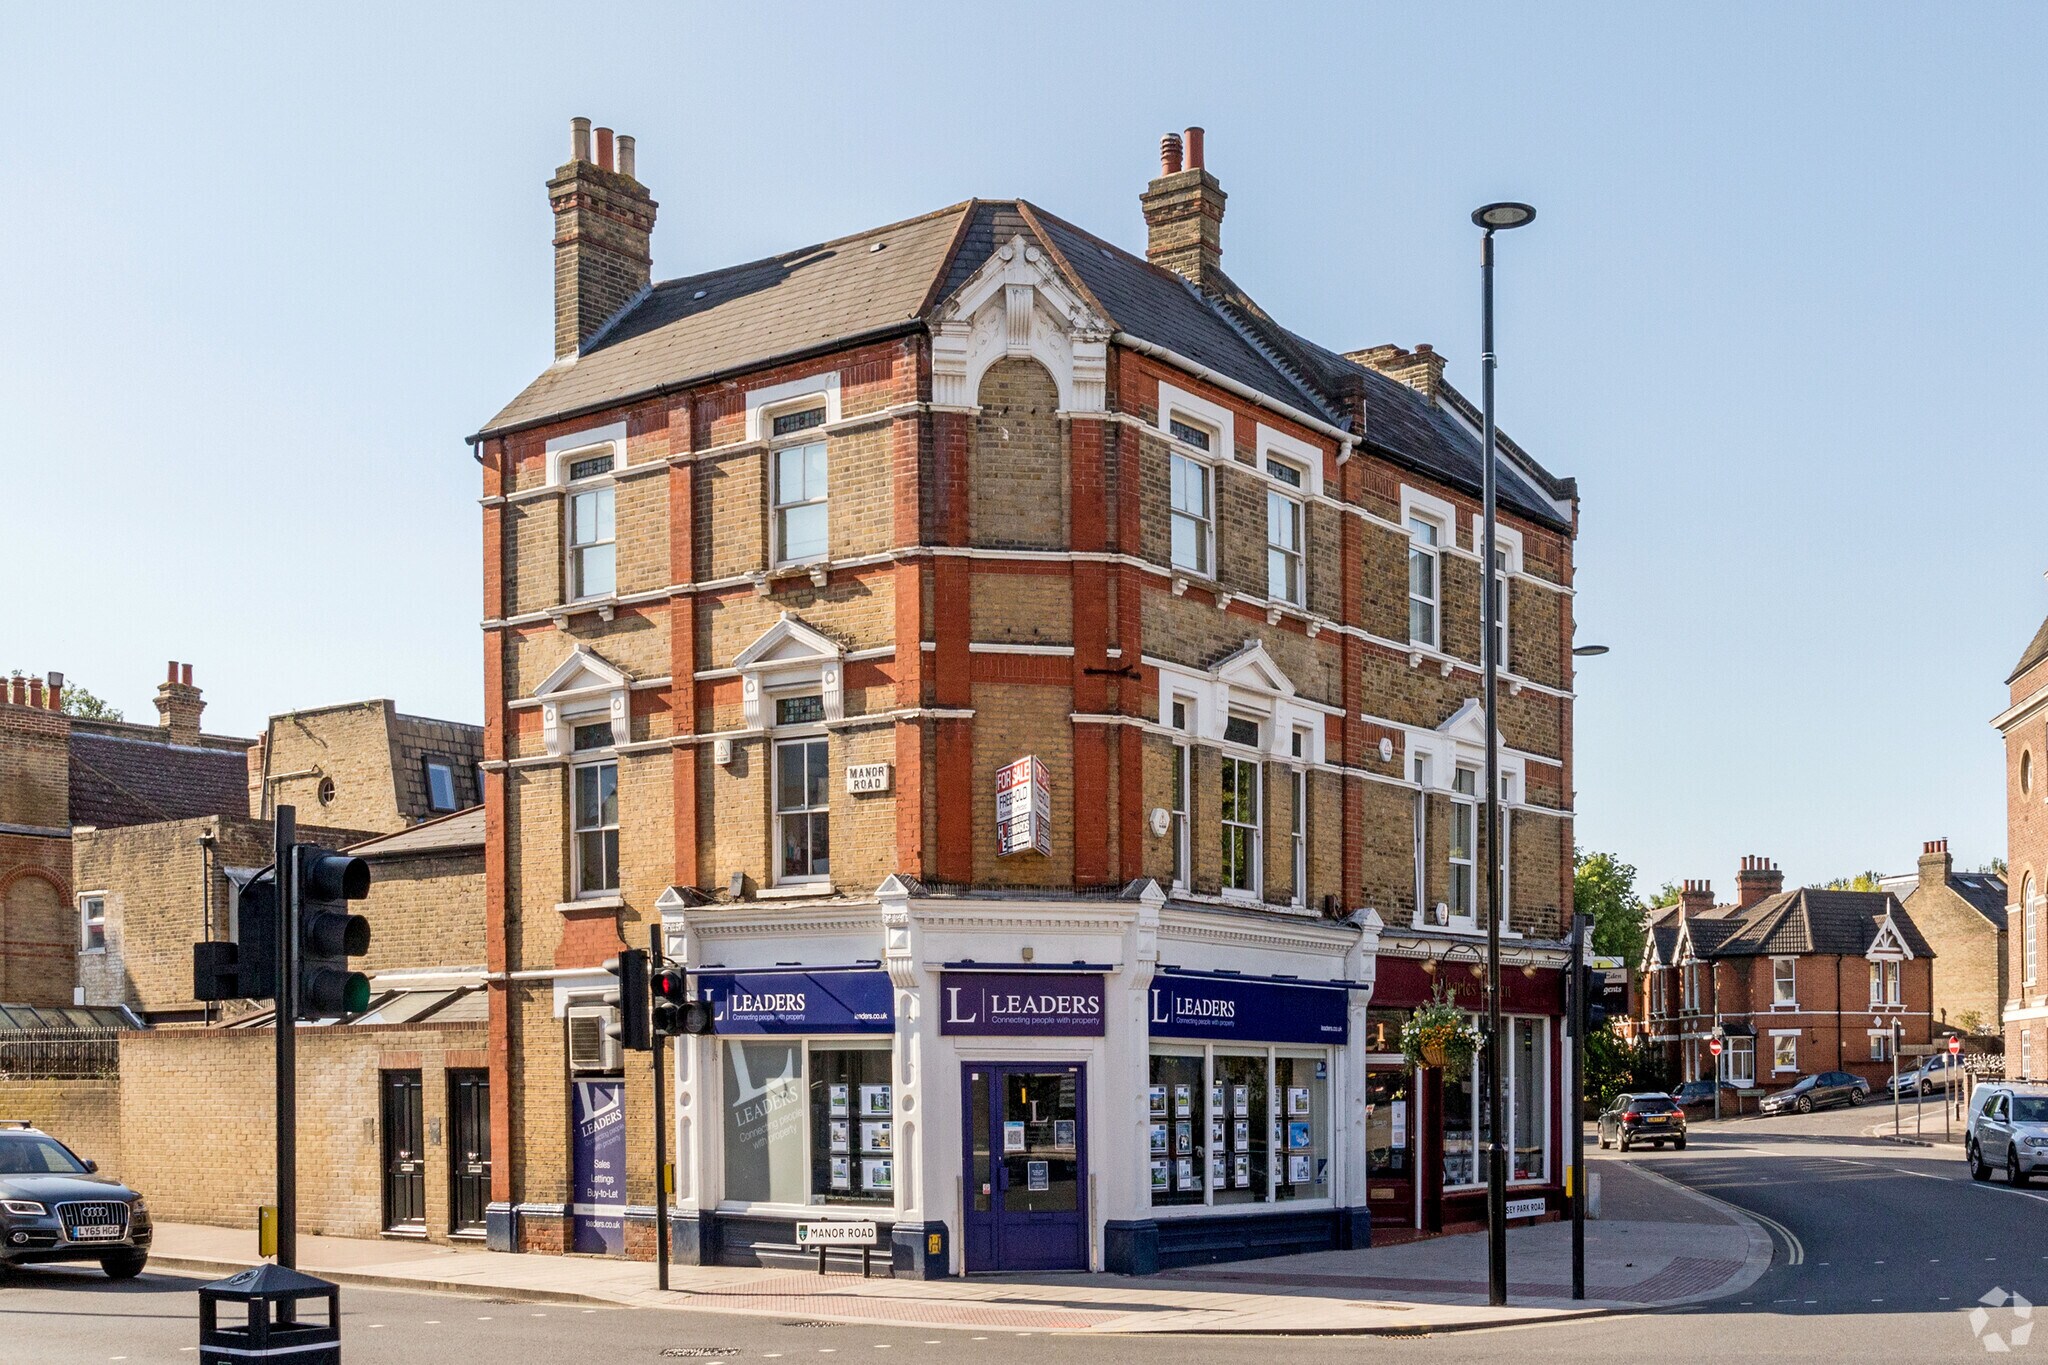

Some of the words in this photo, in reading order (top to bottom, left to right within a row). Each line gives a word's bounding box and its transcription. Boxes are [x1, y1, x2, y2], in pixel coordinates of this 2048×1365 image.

[849, 766, 884, 778] MANOR
[997, 770, 1011, 791] FOR
[1012, 762, 1031, 785] SALE
[853, 778, 881, 790] ROAD
[1603, 986, 1622, 996] gents
[732, 993, 806, 1012] LEADERS
[946, 987, 977, 1023] L
[991, 995, 1100, 1014] LEADERS
[1151, 989, 1169, 1023] L
[1176, 997, 1235, 1018] LEADERS
[732, 1013, 758, 1022] Connecting
[785, 1013, 806, 1021] property
[991, 1015, 1031, 1025] Connecting
[1031, 1016, 1055, 1025] people
[1071, 1017, 1100, 1025] property
[1176, 1016, 1198, 1026] Connecting
[1219, 1020, 1235, 1028] property
[1376, 1022, 1386, 1042] 1
[734, 1085, 799, 1127] LEADERS
[1029, 1100, 1049, 1123] L
[581, 1109, 623, 1138] LEADERS
[609, 1123, 625, 1135] people
[739, 1118, 779, 1143] Connecting
[778, 1108, 803, 1130] people
[603, 1135, 621, 1149] property
[752, 1136, 768, 1150] with
[768, 1124, 798, 1145] property
[593, 1159, 611, 1169] Sales
[590, 1173, 615, 1186] Lettings
[587, 1187, 619, 1200] Buy-to-Let
[1505, 1205, 1516, 1214] SEY
[1516, 1204, 1530, 1213] PARK
[1530, 1202, 1545, 1212] ROAD
[585, 1219, 621, 1229] leaders.co.uk
[78, 1227, 101, 1236] LY65
[810, 1228, 845, 1238] MANOR
[847, 1228, 874, 1238] ROAD
